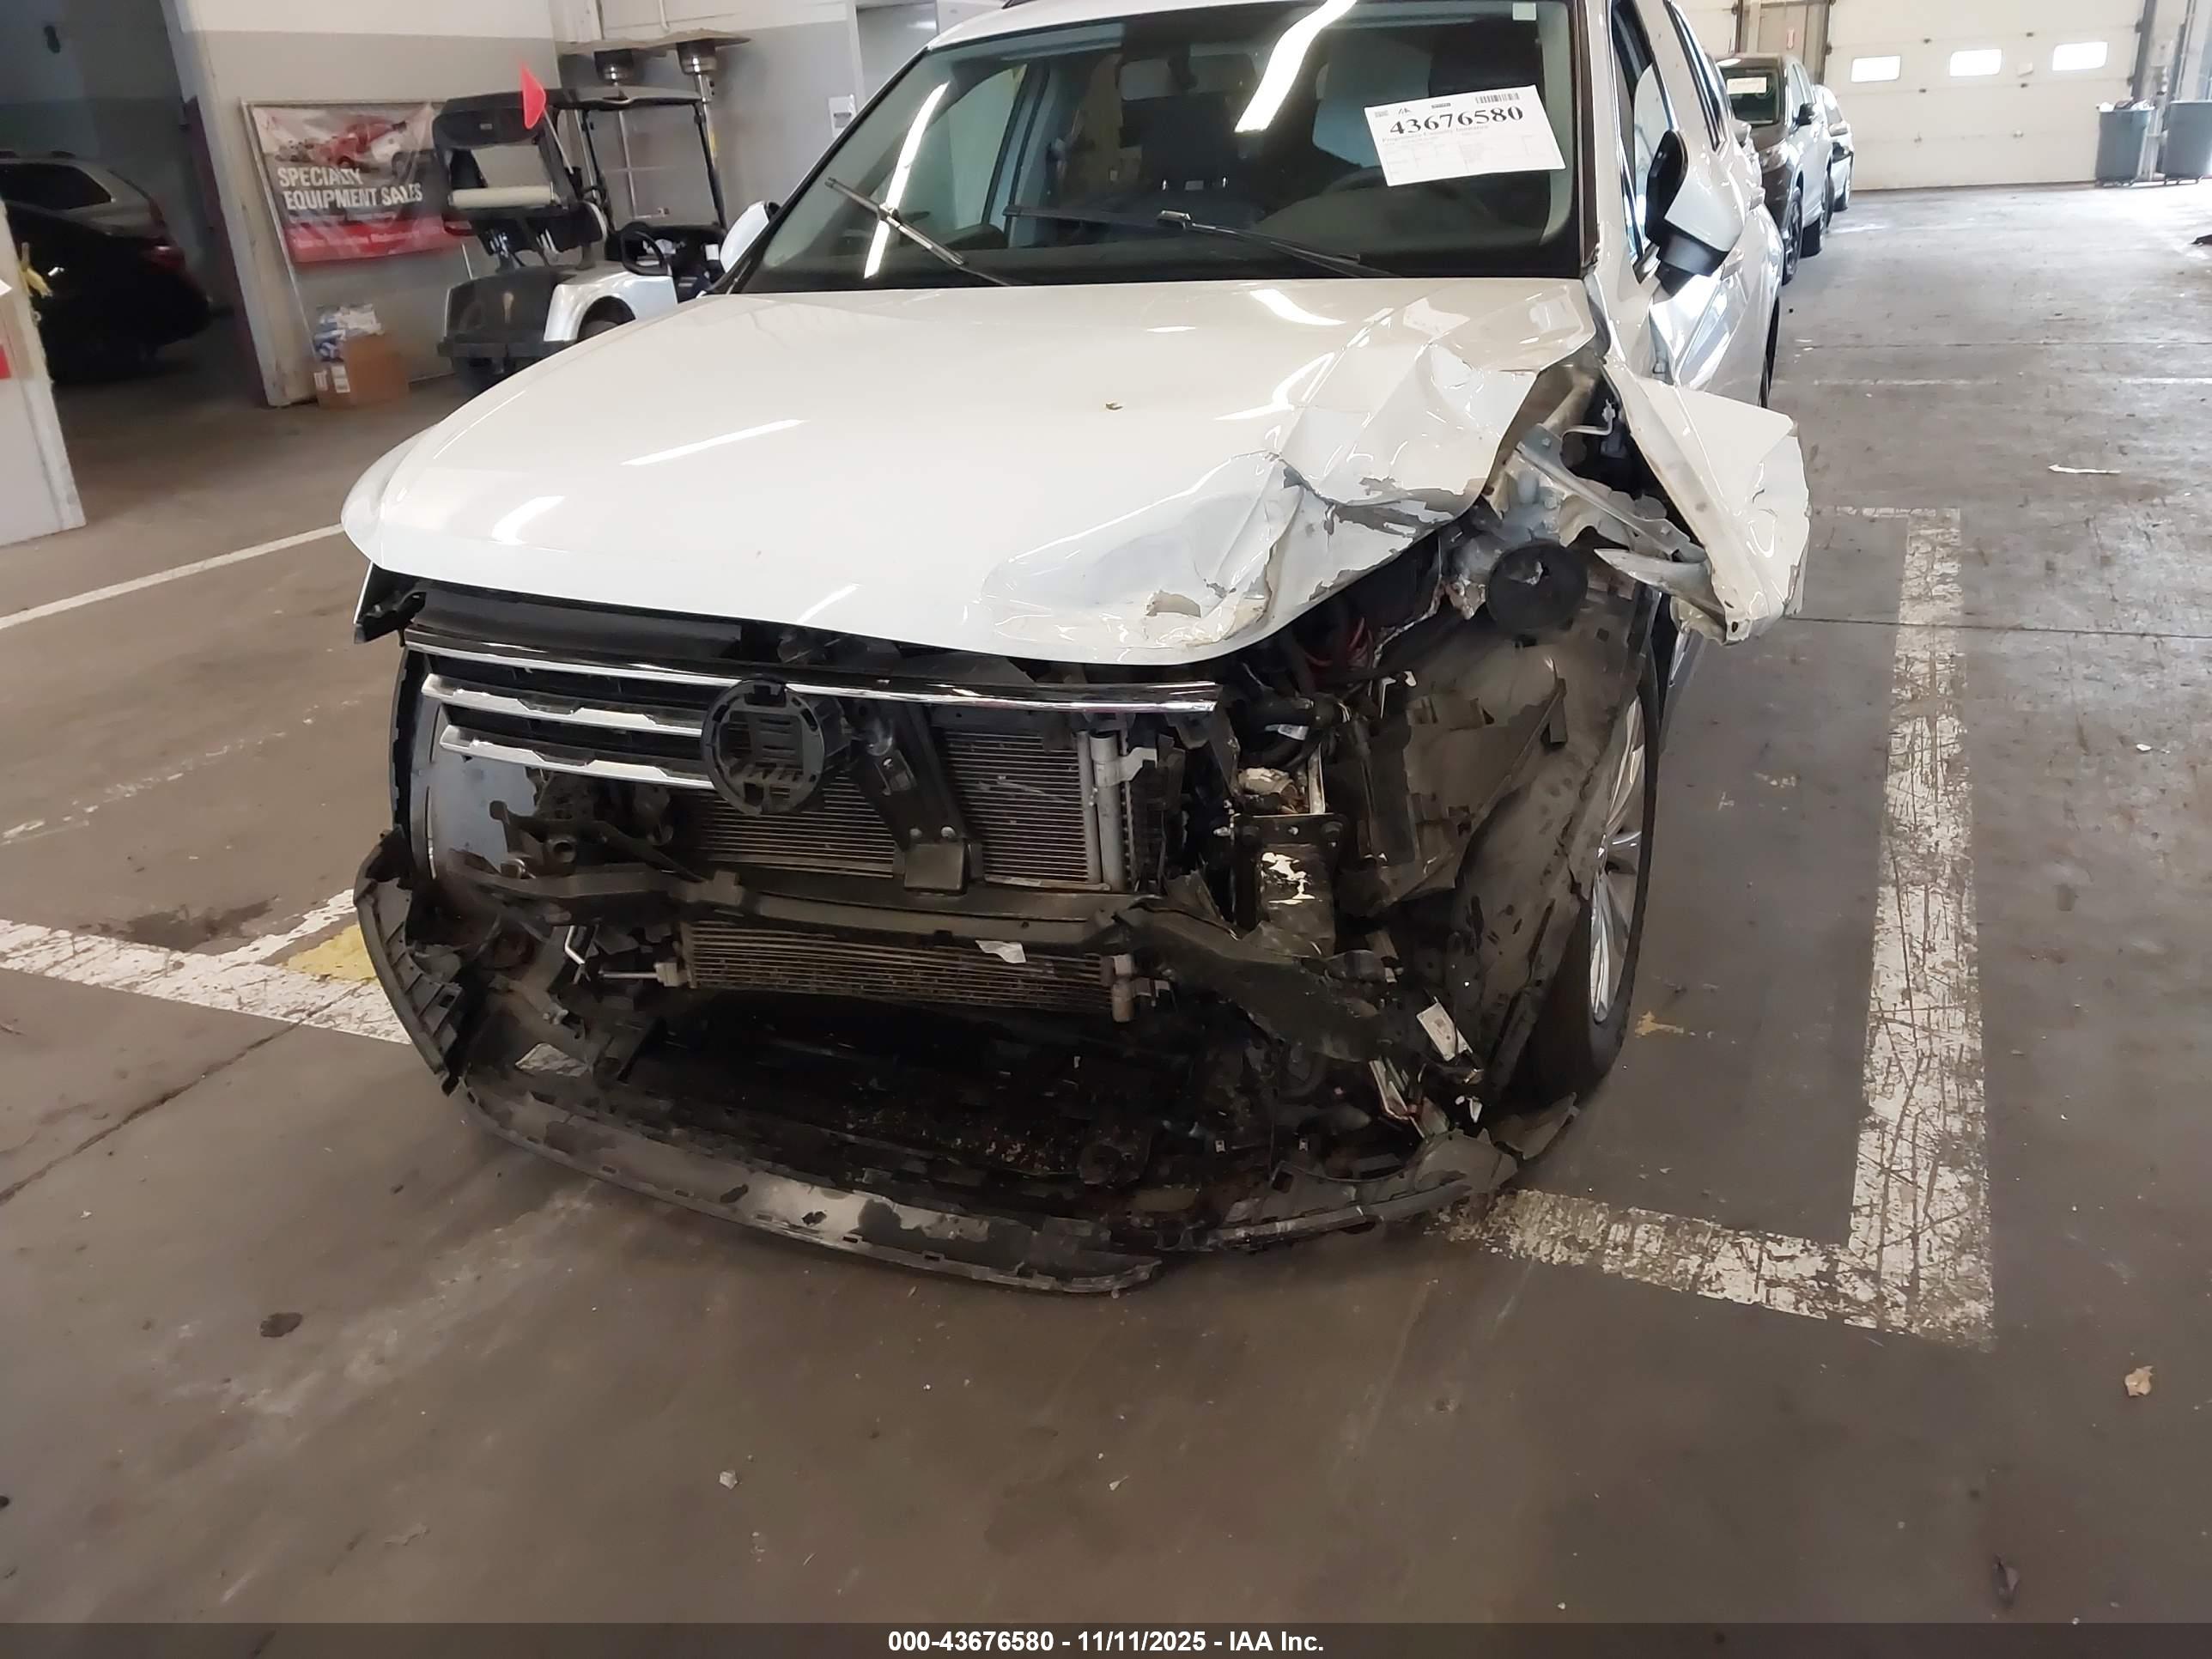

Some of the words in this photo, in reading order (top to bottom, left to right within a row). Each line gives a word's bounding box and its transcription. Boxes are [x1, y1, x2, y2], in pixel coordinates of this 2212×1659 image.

[1389, 106, 1523, 134] 43676580
[276, 167, 363, 187] SPECIALTY
[283, 188, 377, 210] EQUIPMENT
[381, 183, 423, 206] SALES
